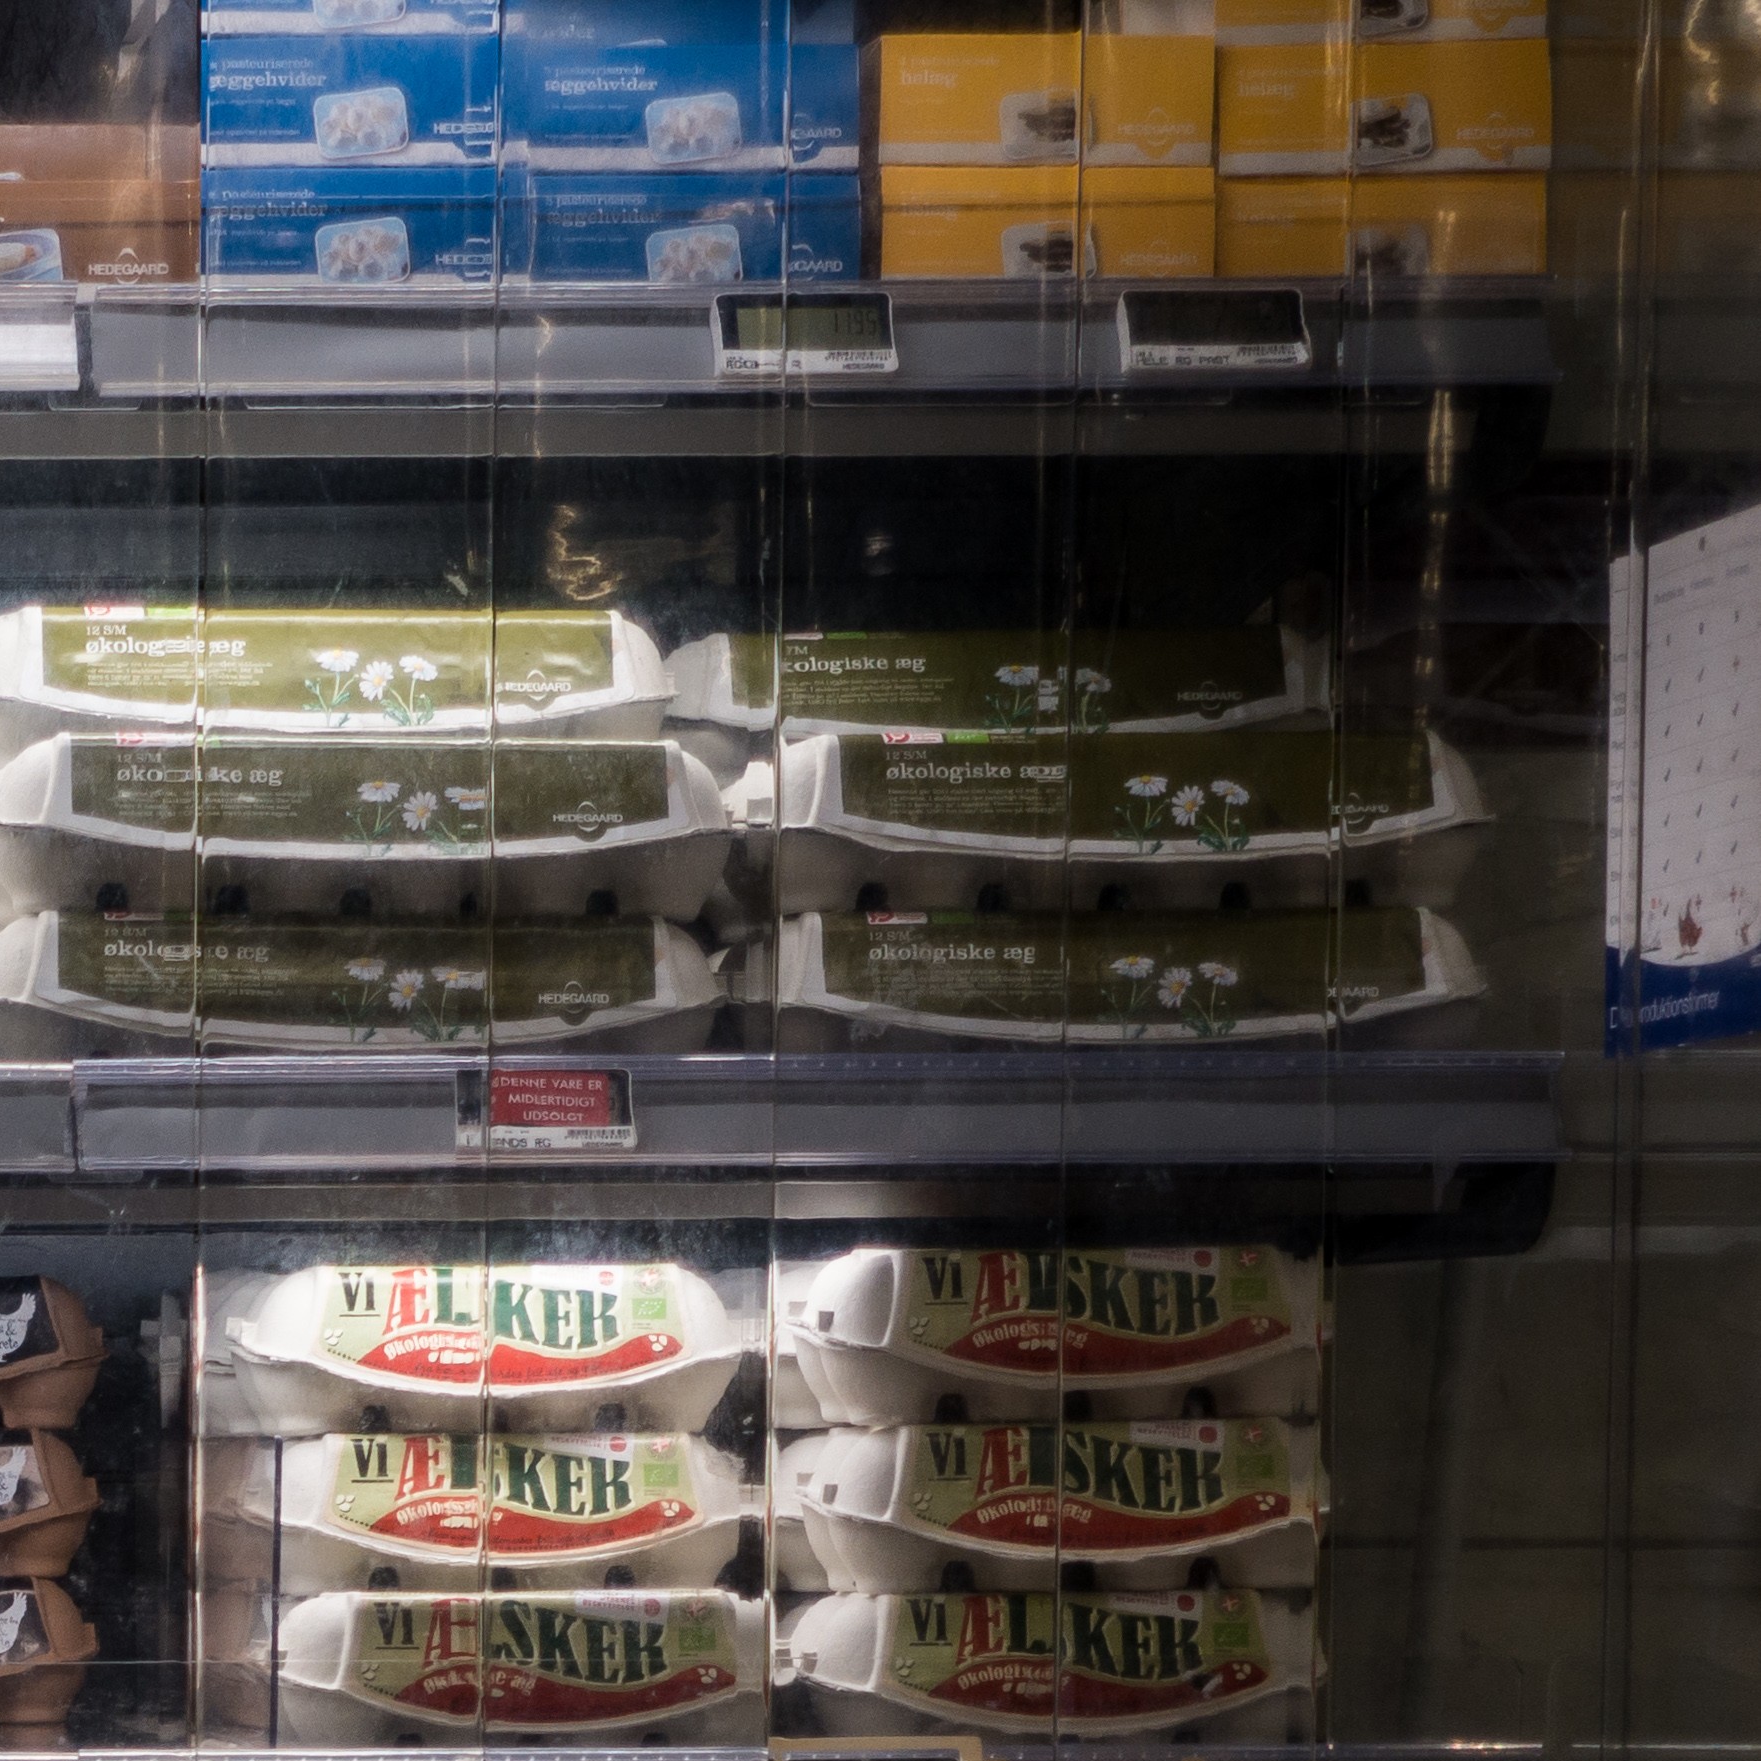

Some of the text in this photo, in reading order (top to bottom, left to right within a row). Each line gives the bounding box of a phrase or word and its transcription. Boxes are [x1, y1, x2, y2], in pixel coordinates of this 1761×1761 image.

[88, 263, 169, 275] HEDEGAARD
[250, 768, 282, 786] æg
[886, 761, 1013, 783] økologiske
[553, 812, 623, 824] HEDEGAARD
[869, 943, 1035, 965] økologiske æg
[499, 1077, 603, 1090] DENNE VARE ER
[508, 1095, 596, 1107] MIDLERTIDIGT
[523, 1110, 584, 1122] UDSOLGT
[383, 1267, 619, 1350] ÆLKER
[351, 1438, 388, 1477] VI
[374, 1603, 414, 1645] VI
[907, 1594, 1203, 1680] VI ÆLKER
